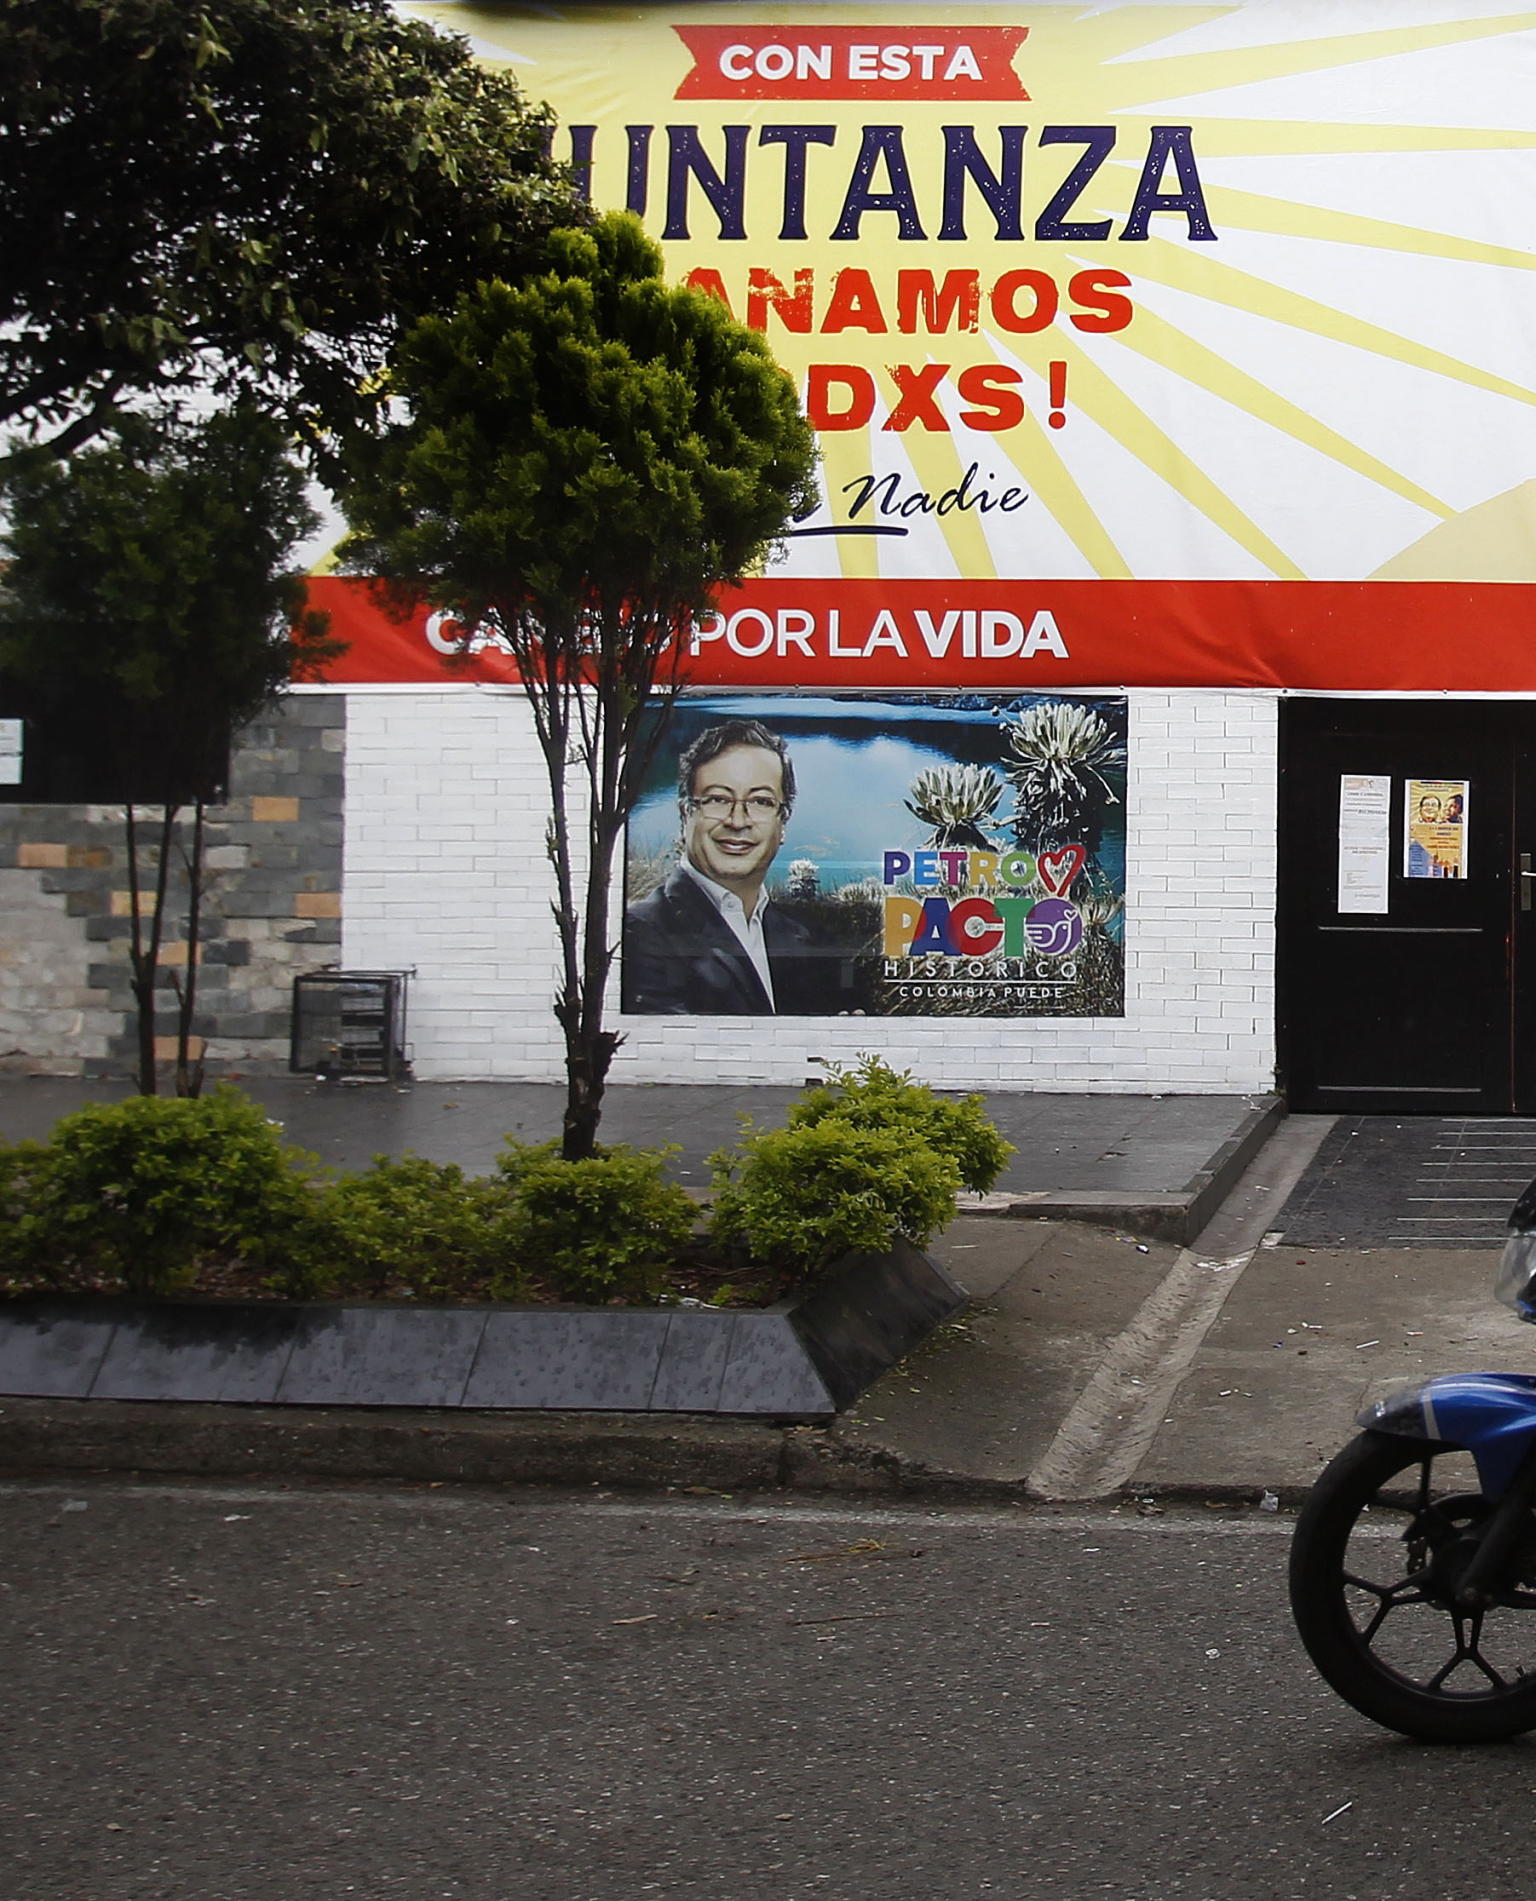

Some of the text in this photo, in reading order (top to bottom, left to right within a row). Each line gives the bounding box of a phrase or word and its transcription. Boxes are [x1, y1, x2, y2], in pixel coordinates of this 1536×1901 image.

[719, 44, 983, 81] CON ESTA
[545, 124, 1219, 241] UNTANZA
[841, 461, 1029, 520] Nadie
[689, 607, 816, 658] POR
[828, 608, 909, 658] LA
[913, 609, 1070, 659] VIDA
[883, 850, 1038, 887] PETRO
[883, 896, 1083, 958] PACTO
[883, 960, 1078, 978] HISTORICO
[899, 985, 1063, 999] COLOMBIA PUEDE
